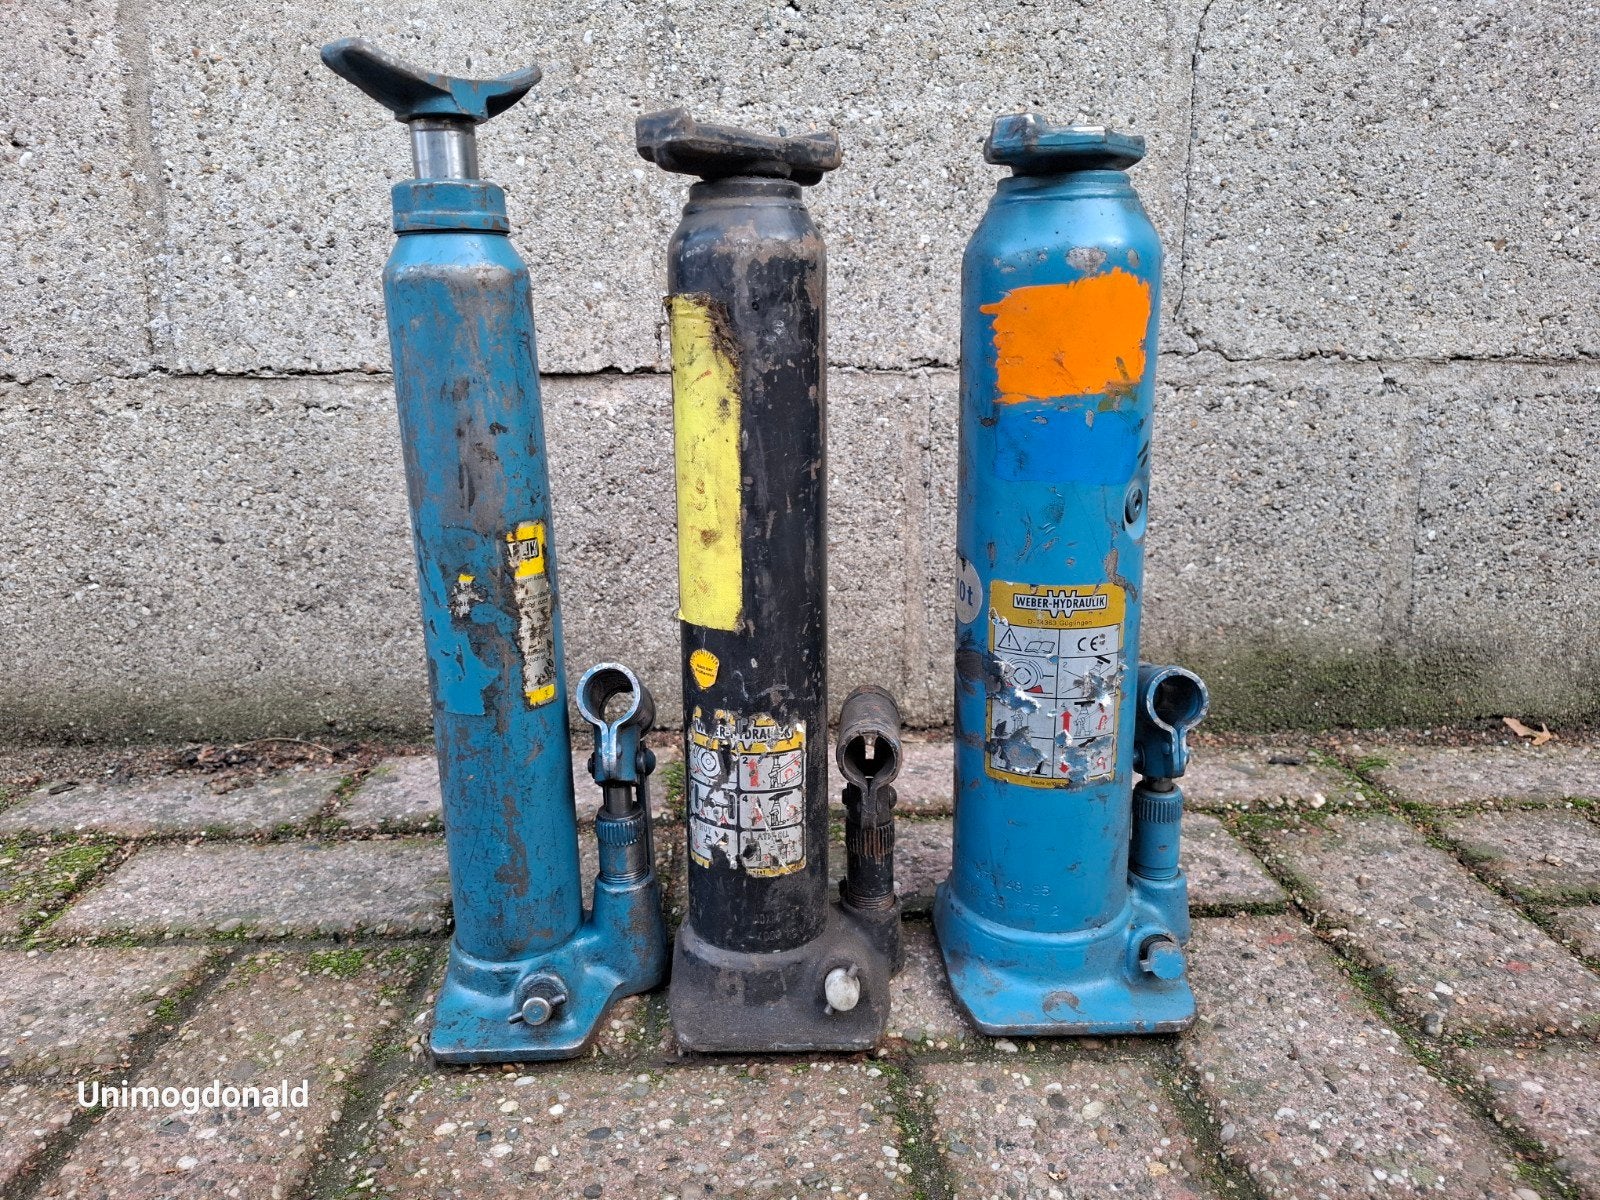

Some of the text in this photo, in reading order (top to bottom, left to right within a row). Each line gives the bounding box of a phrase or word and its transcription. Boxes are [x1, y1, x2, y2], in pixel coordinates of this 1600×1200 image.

[1015, 595, 1105, 610] WEBER-HYDRAULIK
[742, 755, 749, 765] 2
[742, 794, 749, 803] 4
